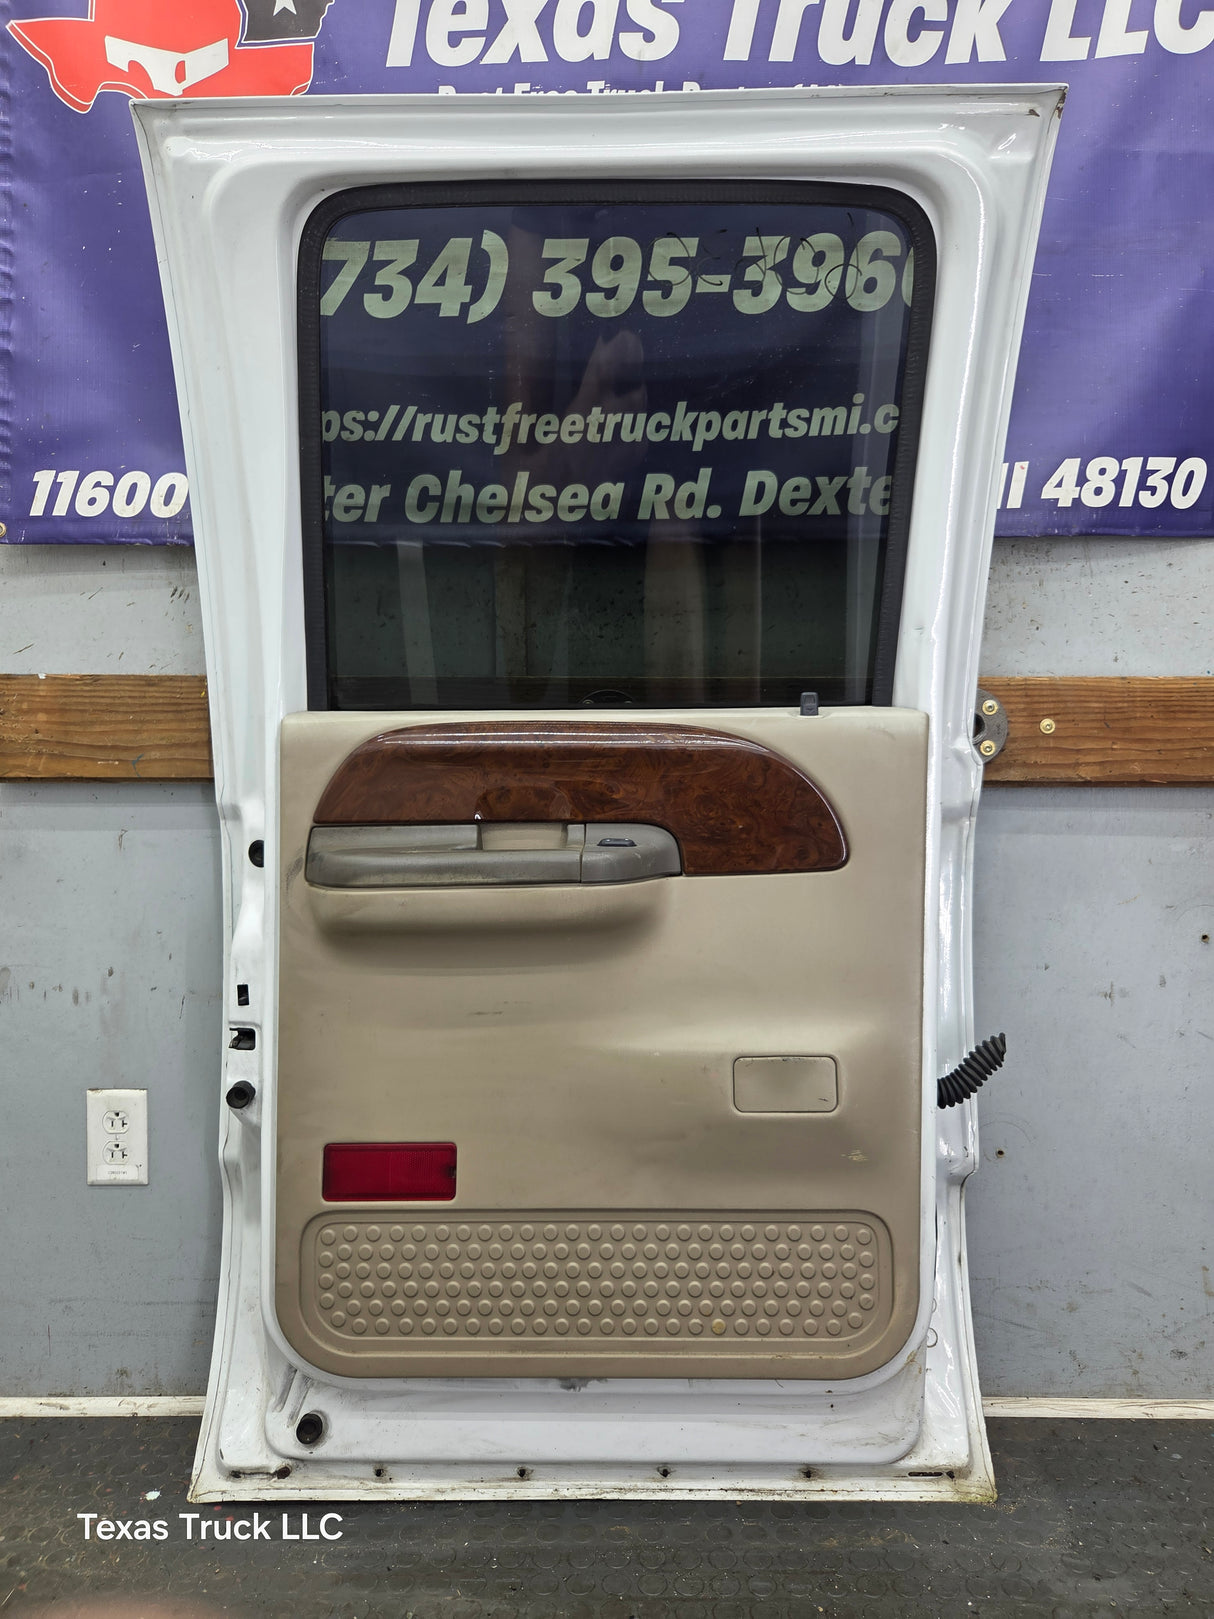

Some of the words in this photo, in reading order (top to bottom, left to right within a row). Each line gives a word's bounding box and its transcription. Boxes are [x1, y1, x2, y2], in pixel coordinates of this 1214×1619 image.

[1039, 0, 1214, 61] LLC
[29, 470, 189, 518] 11600
[404, 470, 625, 523] Chelsea
[637, 467, 722, 520] Rd.
[1040, 456, 1208, 510] 48130
